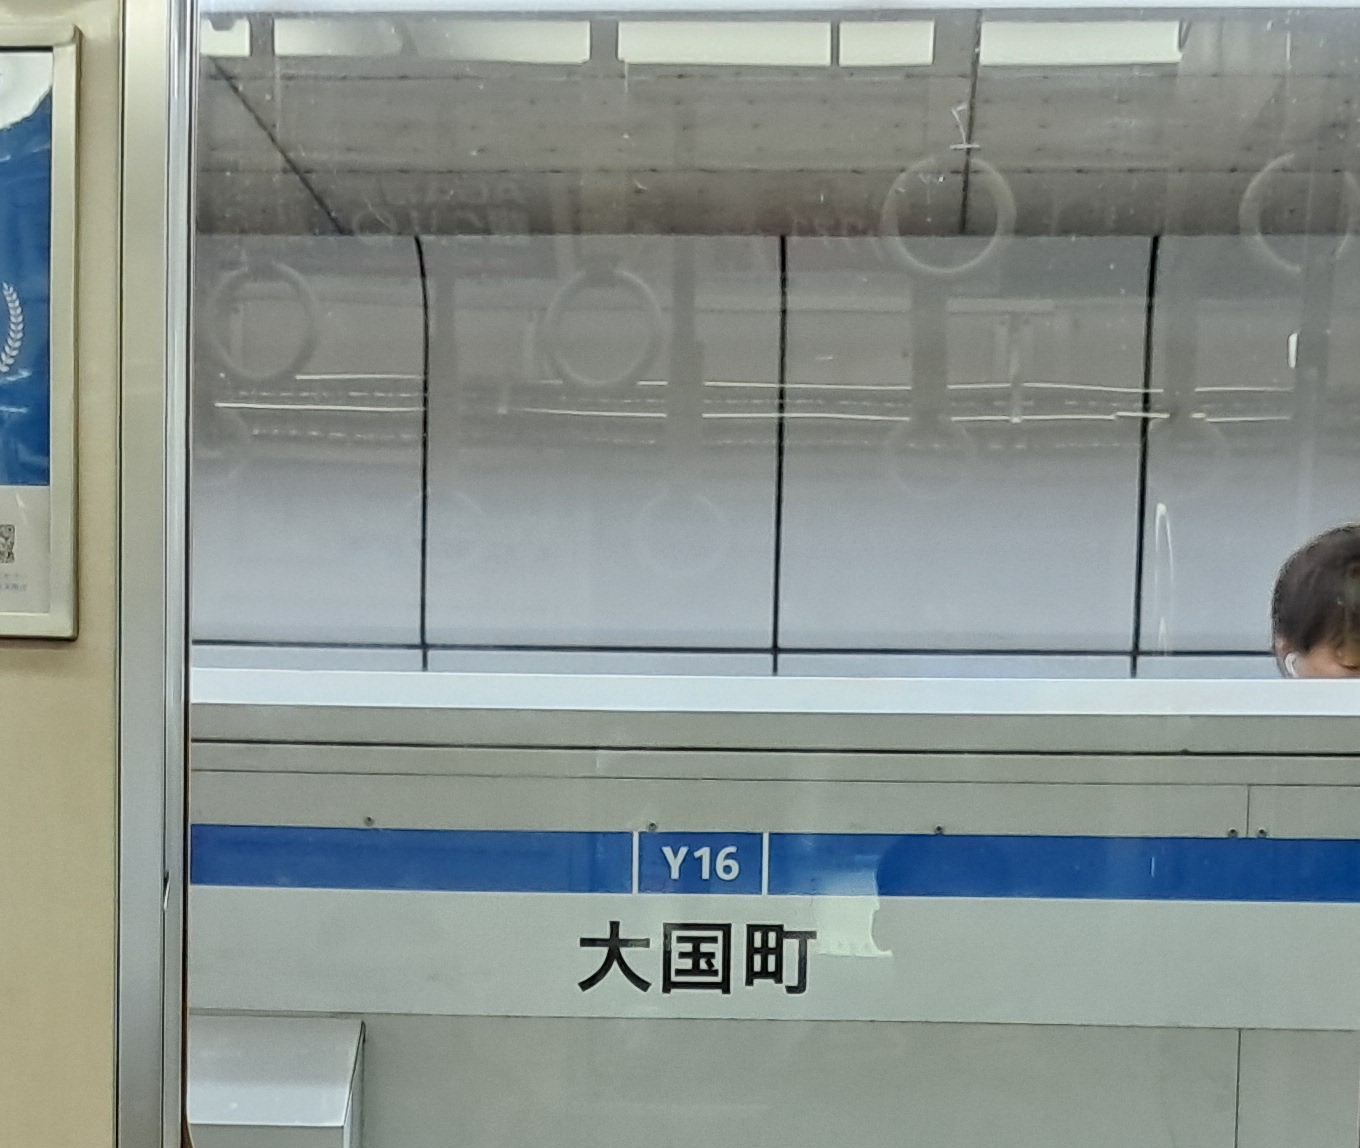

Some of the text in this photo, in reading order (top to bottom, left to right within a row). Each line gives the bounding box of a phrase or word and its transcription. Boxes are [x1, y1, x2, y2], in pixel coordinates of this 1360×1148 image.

[661, 846, 740, 881] Y16
[577, 920, 818, 995] 大国町
